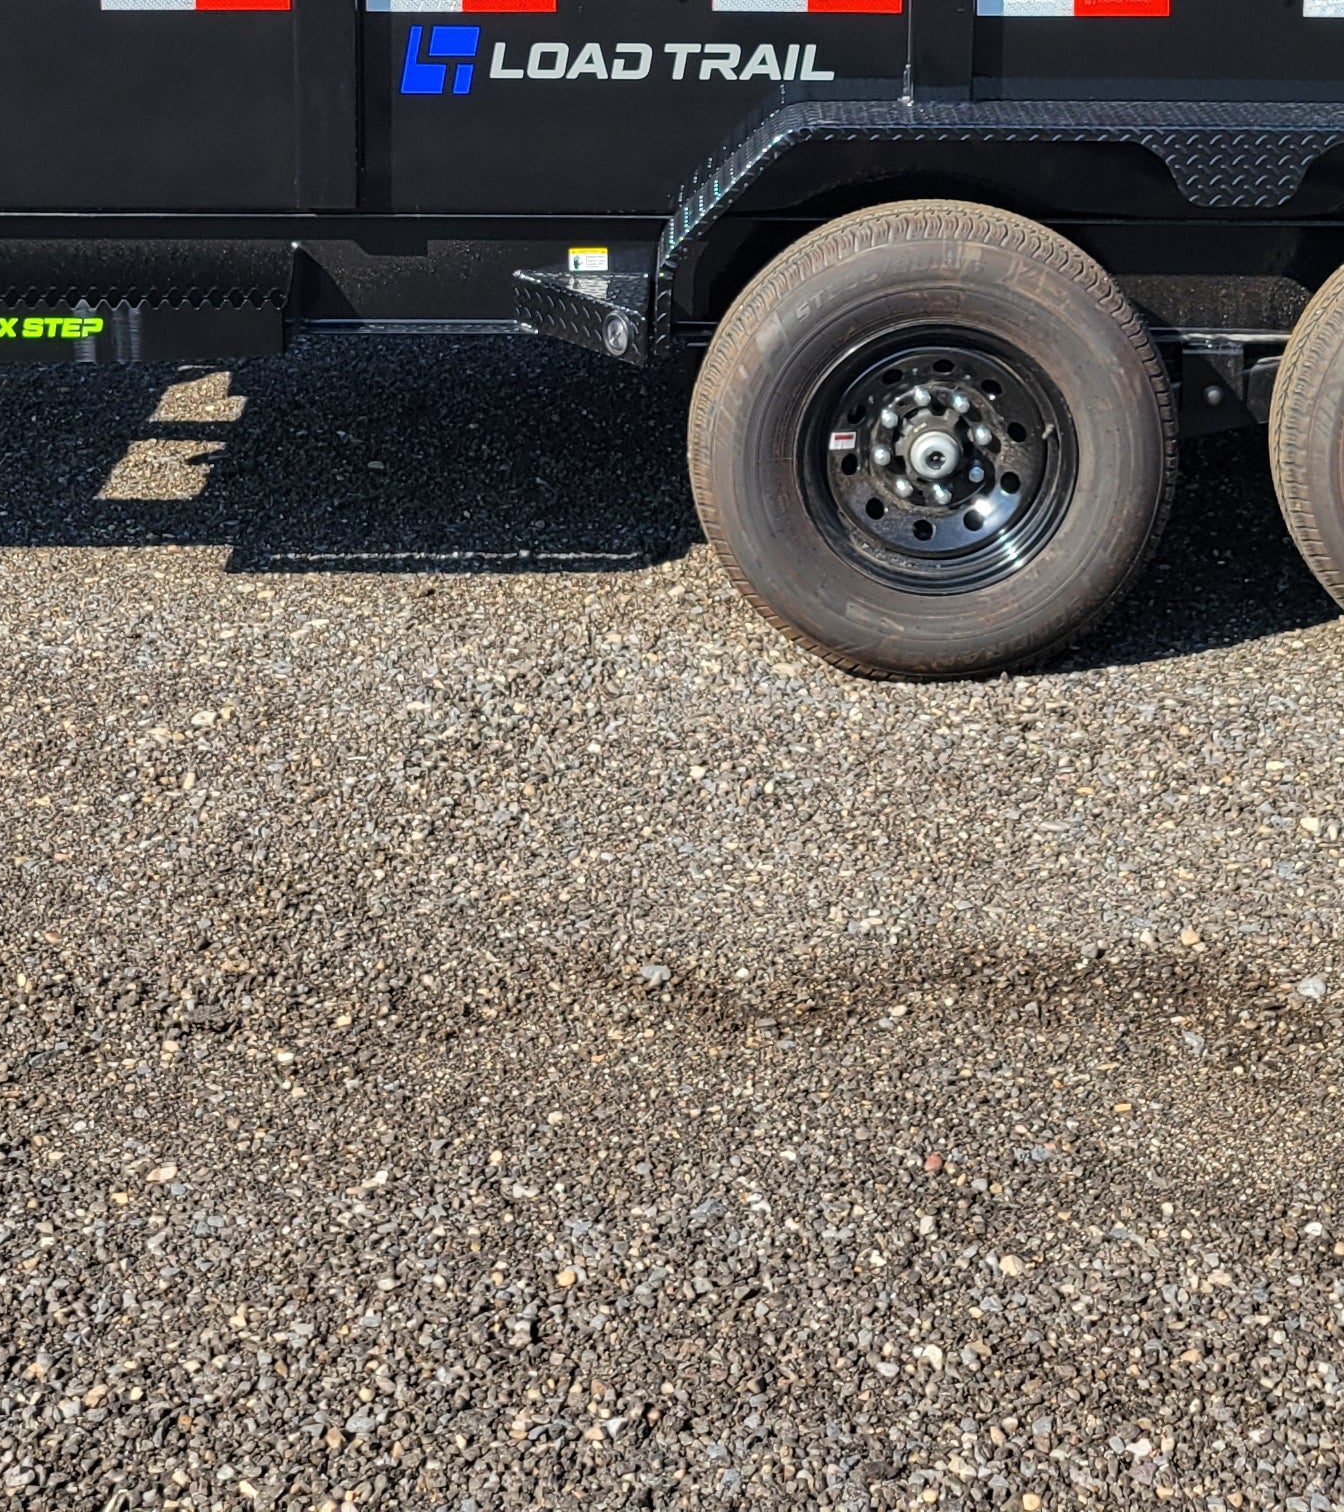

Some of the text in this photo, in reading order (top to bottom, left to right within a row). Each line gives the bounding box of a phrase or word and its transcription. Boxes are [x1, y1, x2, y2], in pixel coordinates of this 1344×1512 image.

[489, 42, 653, 80] LOAD
[664, 43, 835, 81] TRAIL
[22, 317, 104, 338] STEP
